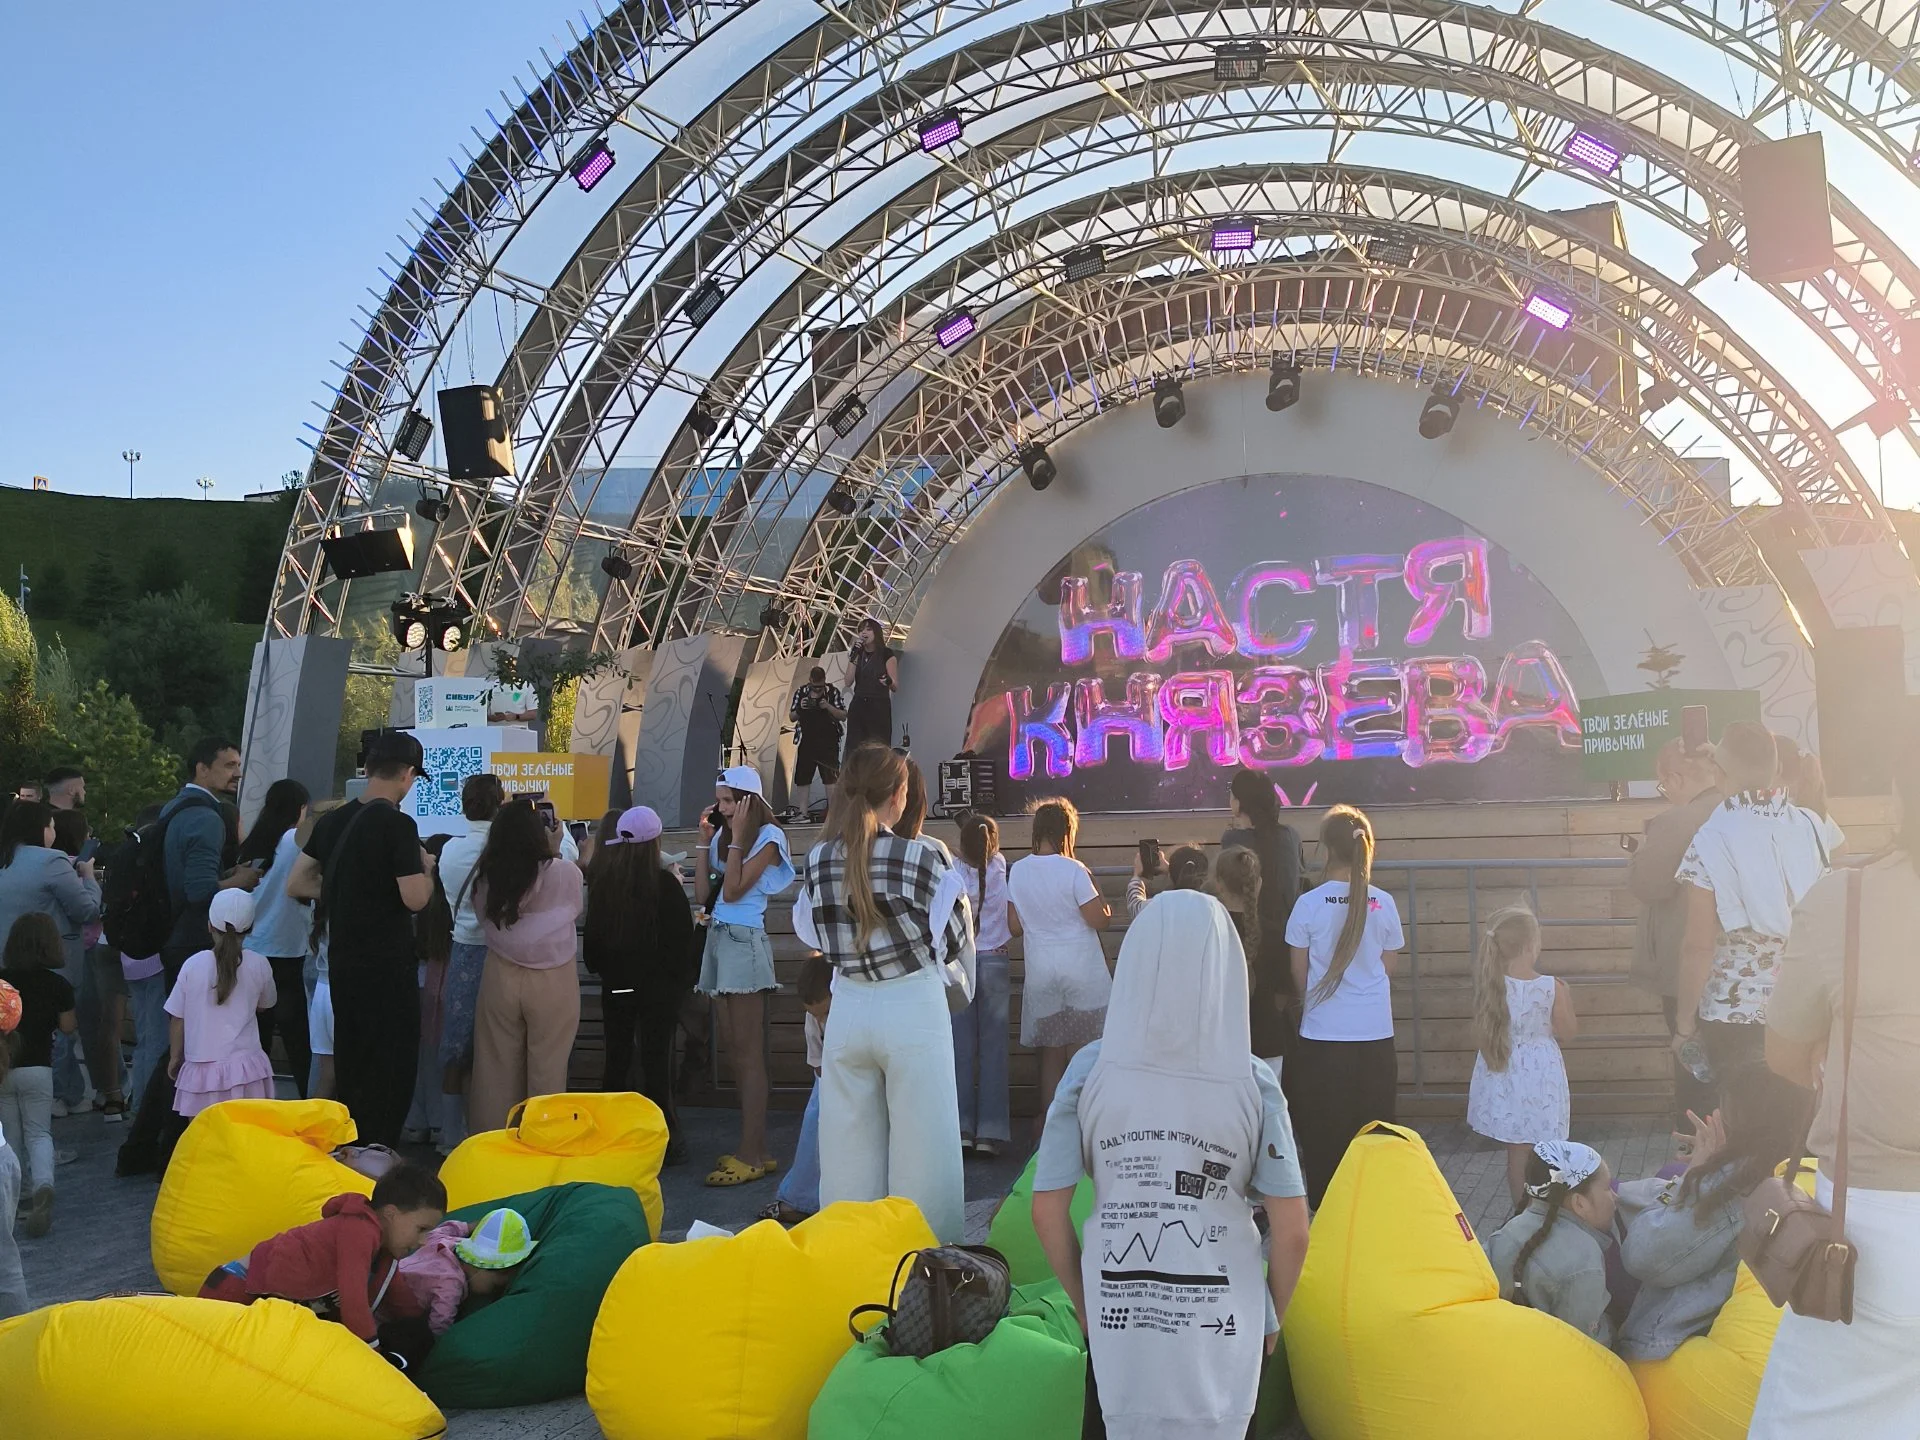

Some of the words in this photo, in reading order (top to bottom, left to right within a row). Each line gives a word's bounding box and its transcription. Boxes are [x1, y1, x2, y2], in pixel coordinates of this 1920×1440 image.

[1060, 537, 1493, 665] НАСТЯ
[1006, 640, 1582, 780] КНЯЗЕВА
[1583, 714, 1610, 734] ТВОИ
[1614, 709, 1669, 730] ЗЕЛЁНЫЕ
[1584, 734, 1645, 754] ПРИВЫЧКИ
[491, 763, 518, 776] ТВОИ
[521, 761, 575, 776] ЗЕЛЁНЫЕ
[501, 780, 550, 792] РИВЫЧКИ
[1100, 1133, 1126, 1150] DAILY
[1168, 1129, 1210, 1153] INTERVAL
[1226, 1313, 1235, 1328] 4
